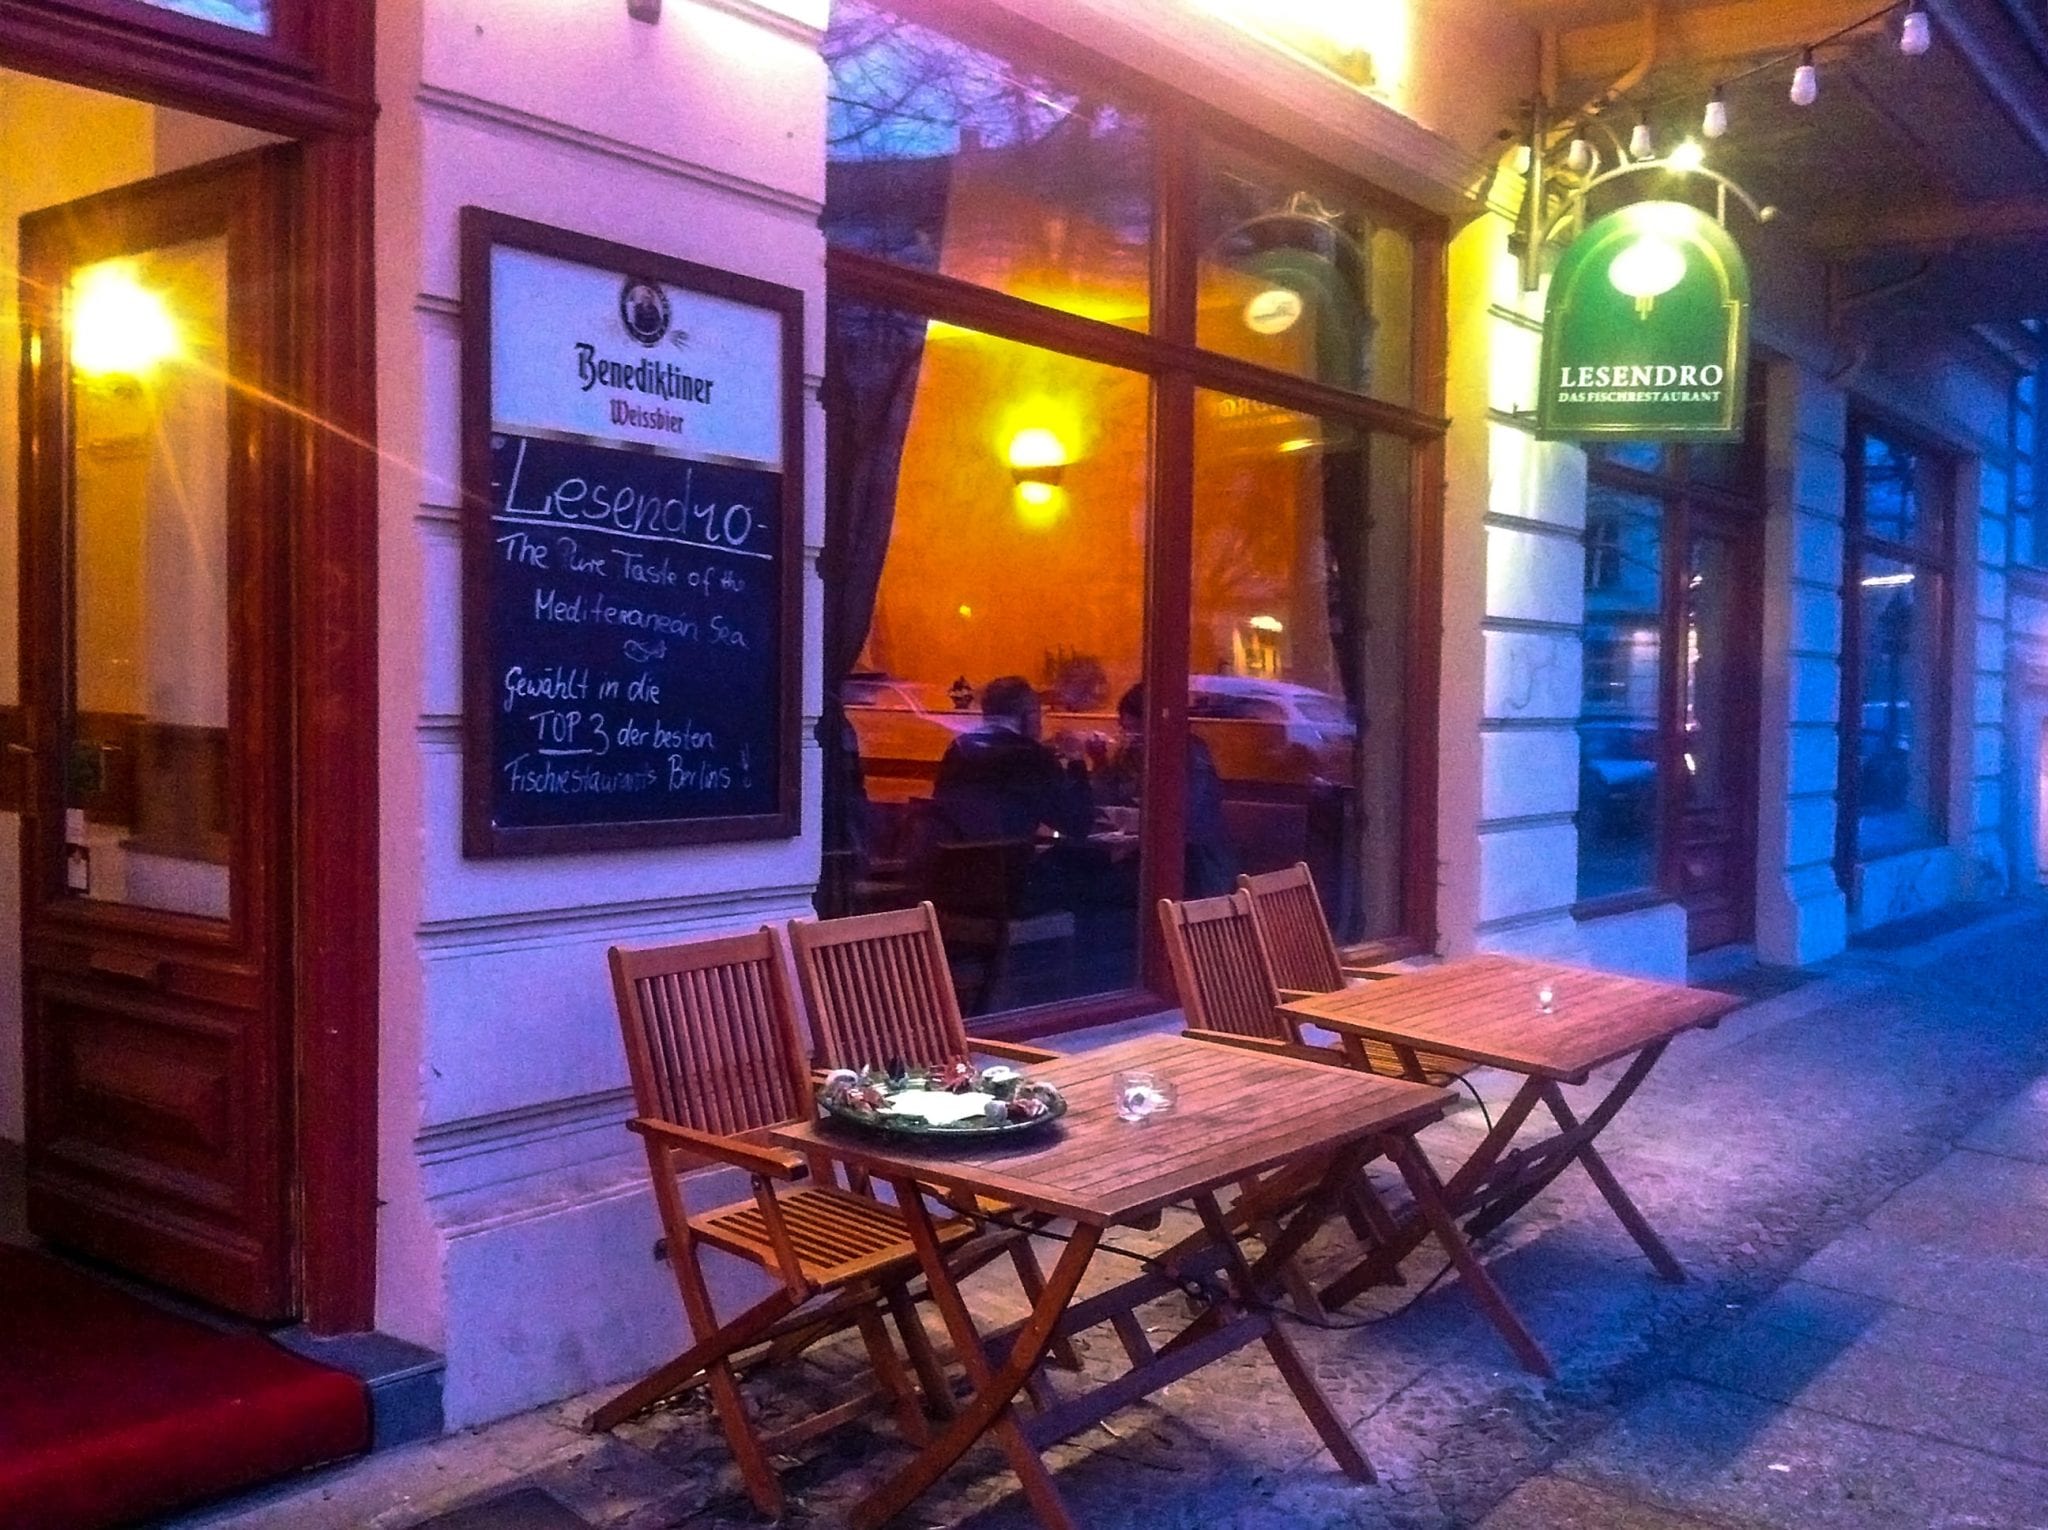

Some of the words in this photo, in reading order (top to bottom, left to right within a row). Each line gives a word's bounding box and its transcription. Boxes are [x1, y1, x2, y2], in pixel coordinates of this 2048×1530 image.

[575, 342, 713, 404] Benediktiner
[1560, 364, 1724, 388] LESENDRO
[610, 399, 684, 433] Weissbier
[1558, 391, 1587, 403] DAS
[1588, 391, 1721, 403] FISCHRESTAURANT
[496, 532, 549, 569] The
[611, 549, 677, 586] Taste
[688, 567, 714, 597] of
[710, 615, 750, 649] Sea
[504, 666, 588, 712] Gewählt
[599, 672, 619, 700] in
[628, 672, 660, 704] die
[529, 710, 582, 742] TOP
[589, 712, 609, 755] 3
[617, 718, 648, 746] der
[653, 718, 715, 749] besten
[668, 754, 731, 792] Berlins
